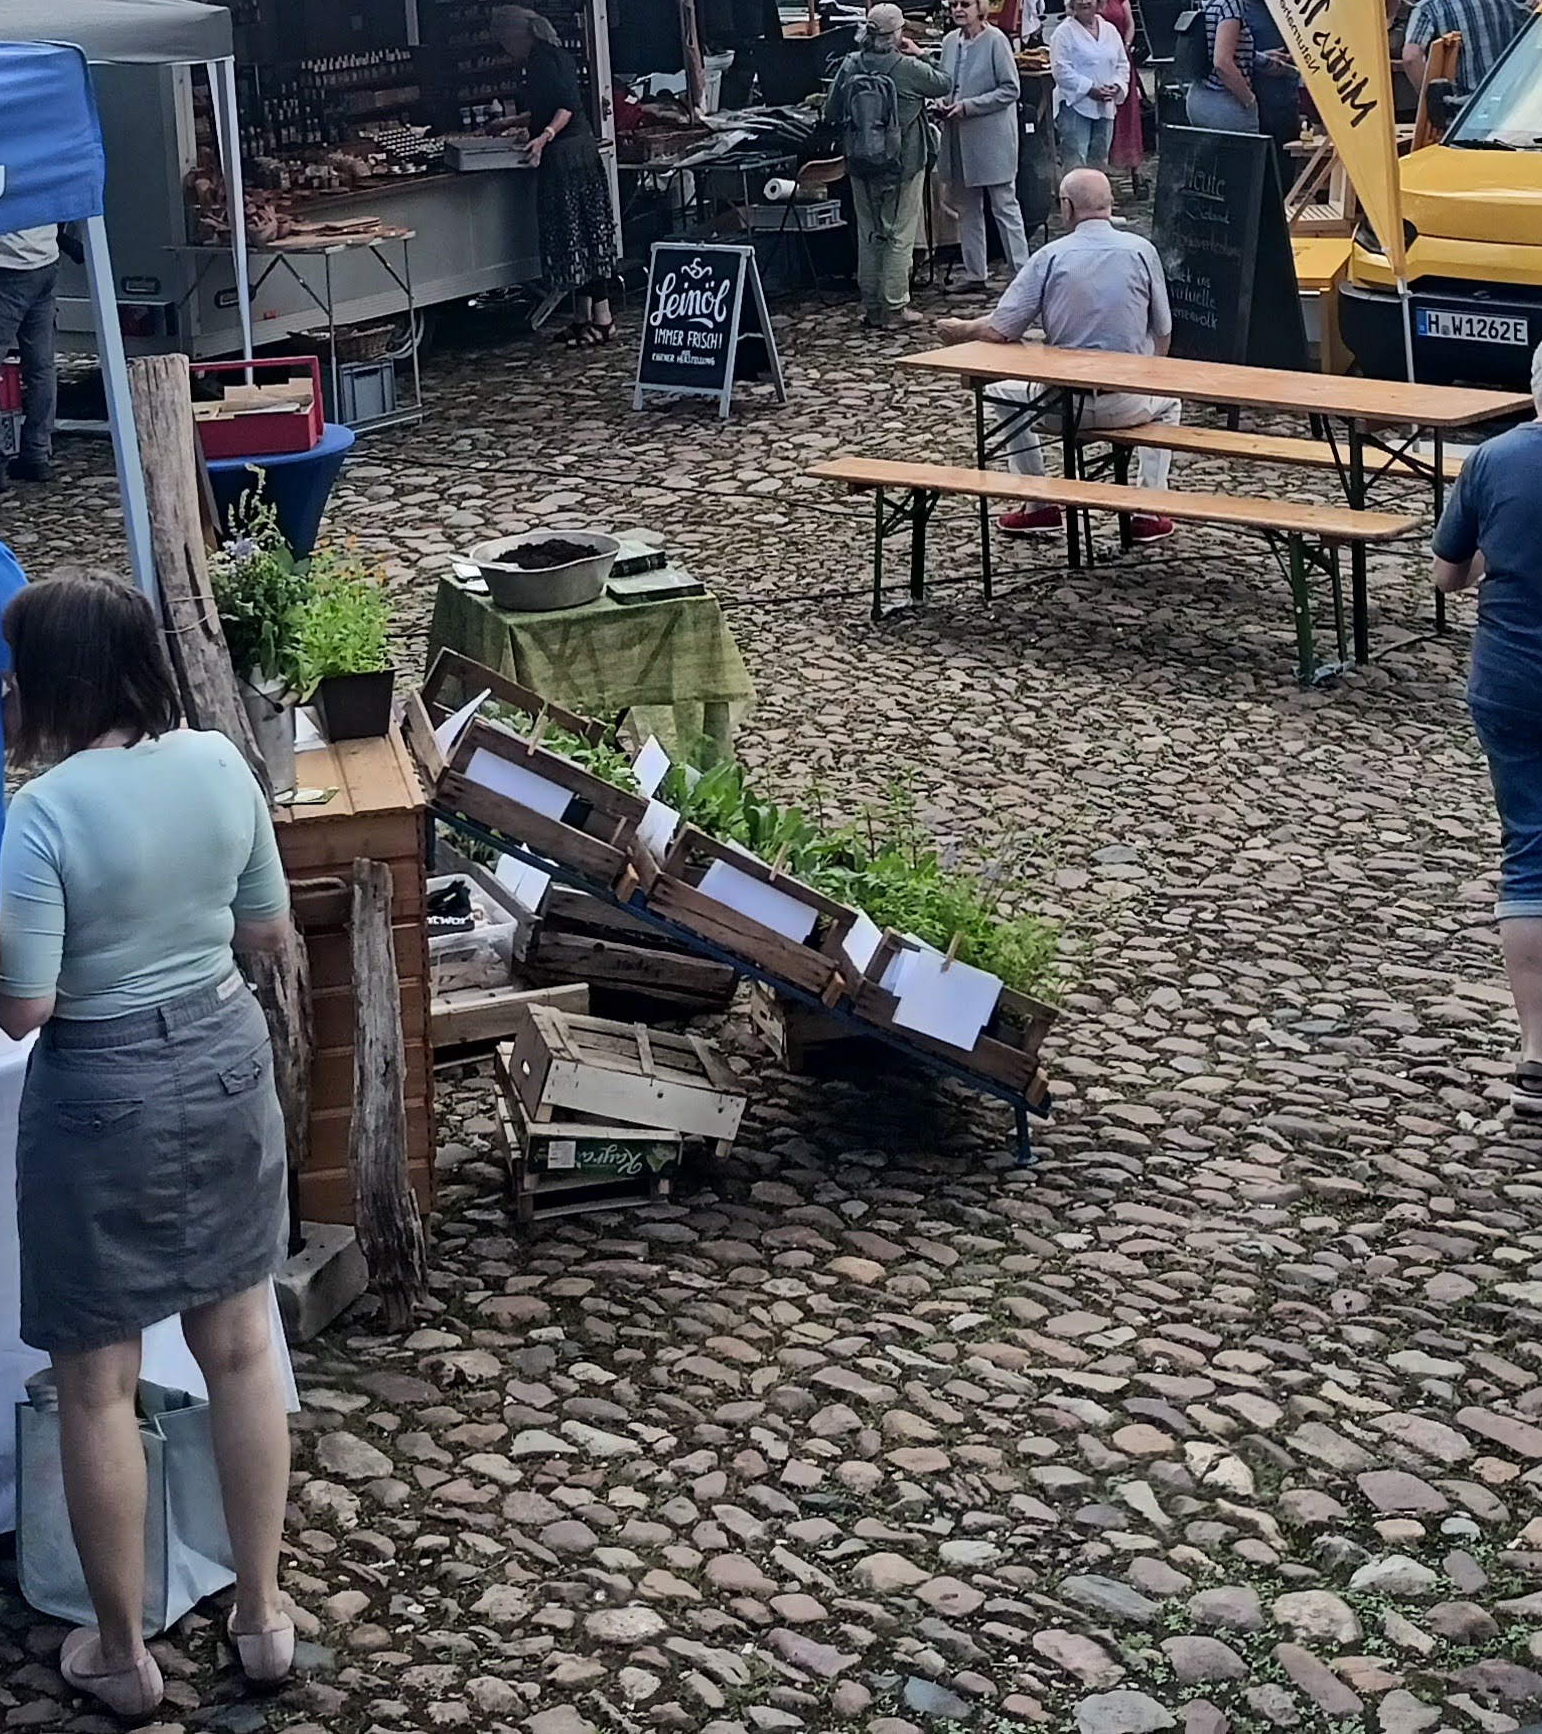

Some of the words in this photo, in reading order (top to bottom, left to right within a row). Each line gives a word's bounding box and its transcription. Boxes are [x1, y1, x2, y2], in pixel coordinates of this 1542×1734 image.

[650, 272, 731, 326] Leinöl
[1428, 313, 1440, 334] H
[654, 327, 684, 346] IMMER
[687, 330, 723, 350] FRISCH!
